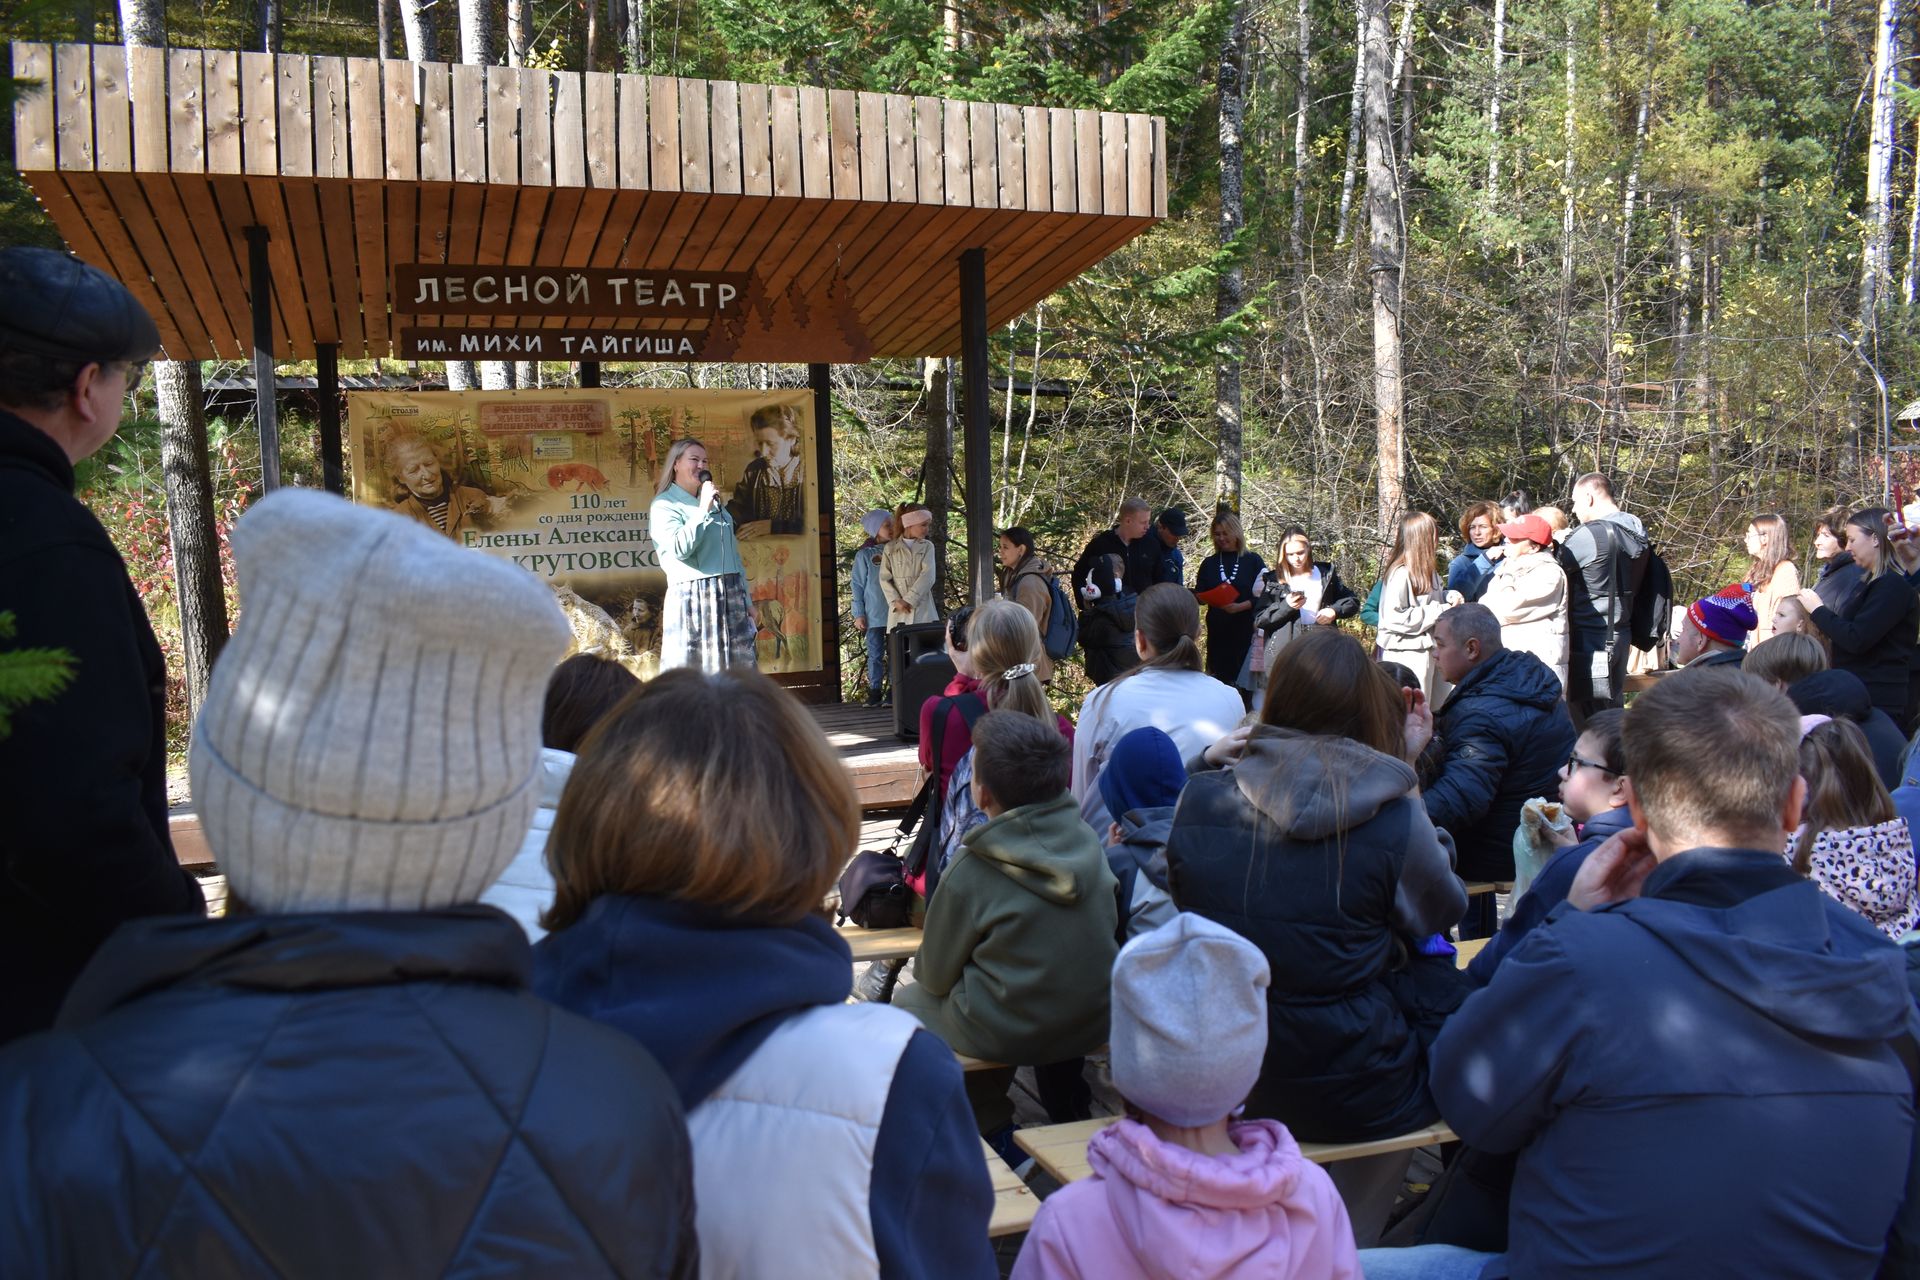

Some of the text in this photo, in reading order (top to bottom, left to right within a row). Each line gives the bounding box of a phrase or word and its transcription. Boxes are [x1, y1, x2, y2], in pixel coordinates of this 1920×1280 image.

[414, 273, 737, 309] ЛЕСНОЙ ТЕАТР
[417, 334, 695, 355] им. МИХИ ТАЙГИША
[570, 494, 627, 510] 110 лет
[538, 511, 649, 526] со дня рождени
[463, 527, 652, 549] Елены Александ
[512, 549, 660, 577] КРУТОВСКО
